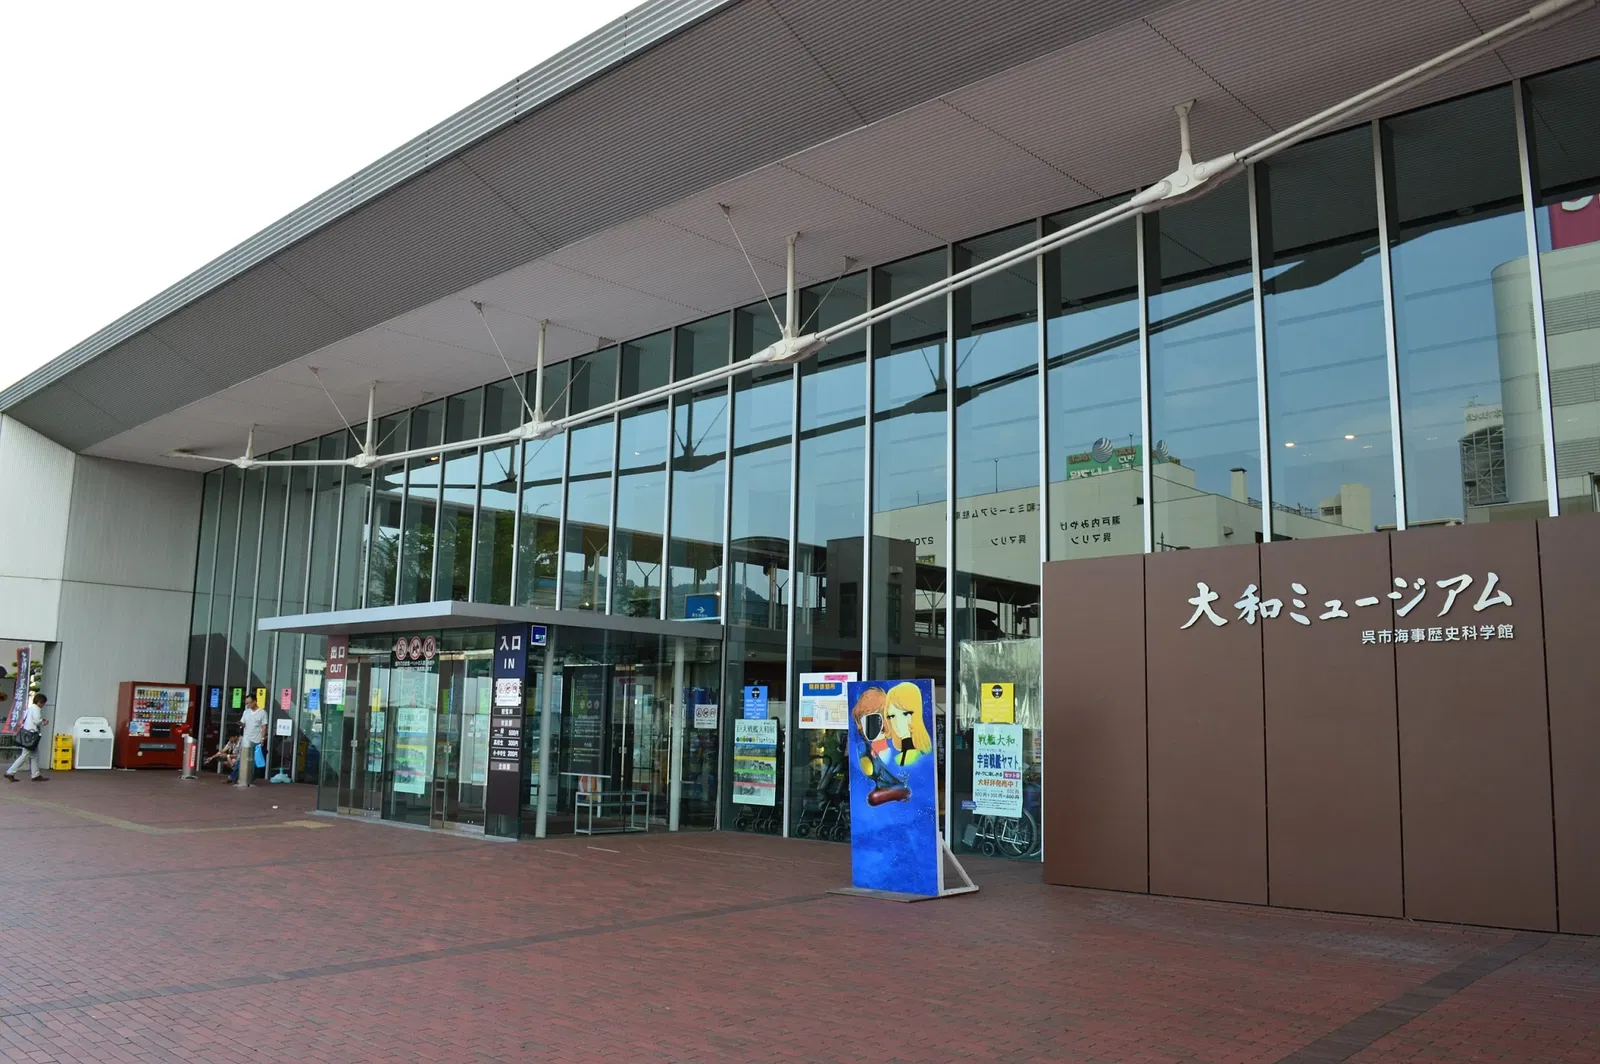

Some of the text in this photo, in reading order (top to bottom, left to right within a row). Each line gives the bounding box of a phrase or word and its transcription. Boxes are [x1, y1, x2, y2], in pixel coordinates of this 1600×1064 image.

[1180, 571, 1513, 630] 大和ミュージアム
[1361, 624, 1515, 645] 呉市海事歴史科学館
[499, 635, 521, 651] 入口
[330, 646, 345, 660] 出口
[330, 663, 343, 674] OUT
[503, 657, 515, 669] IN
